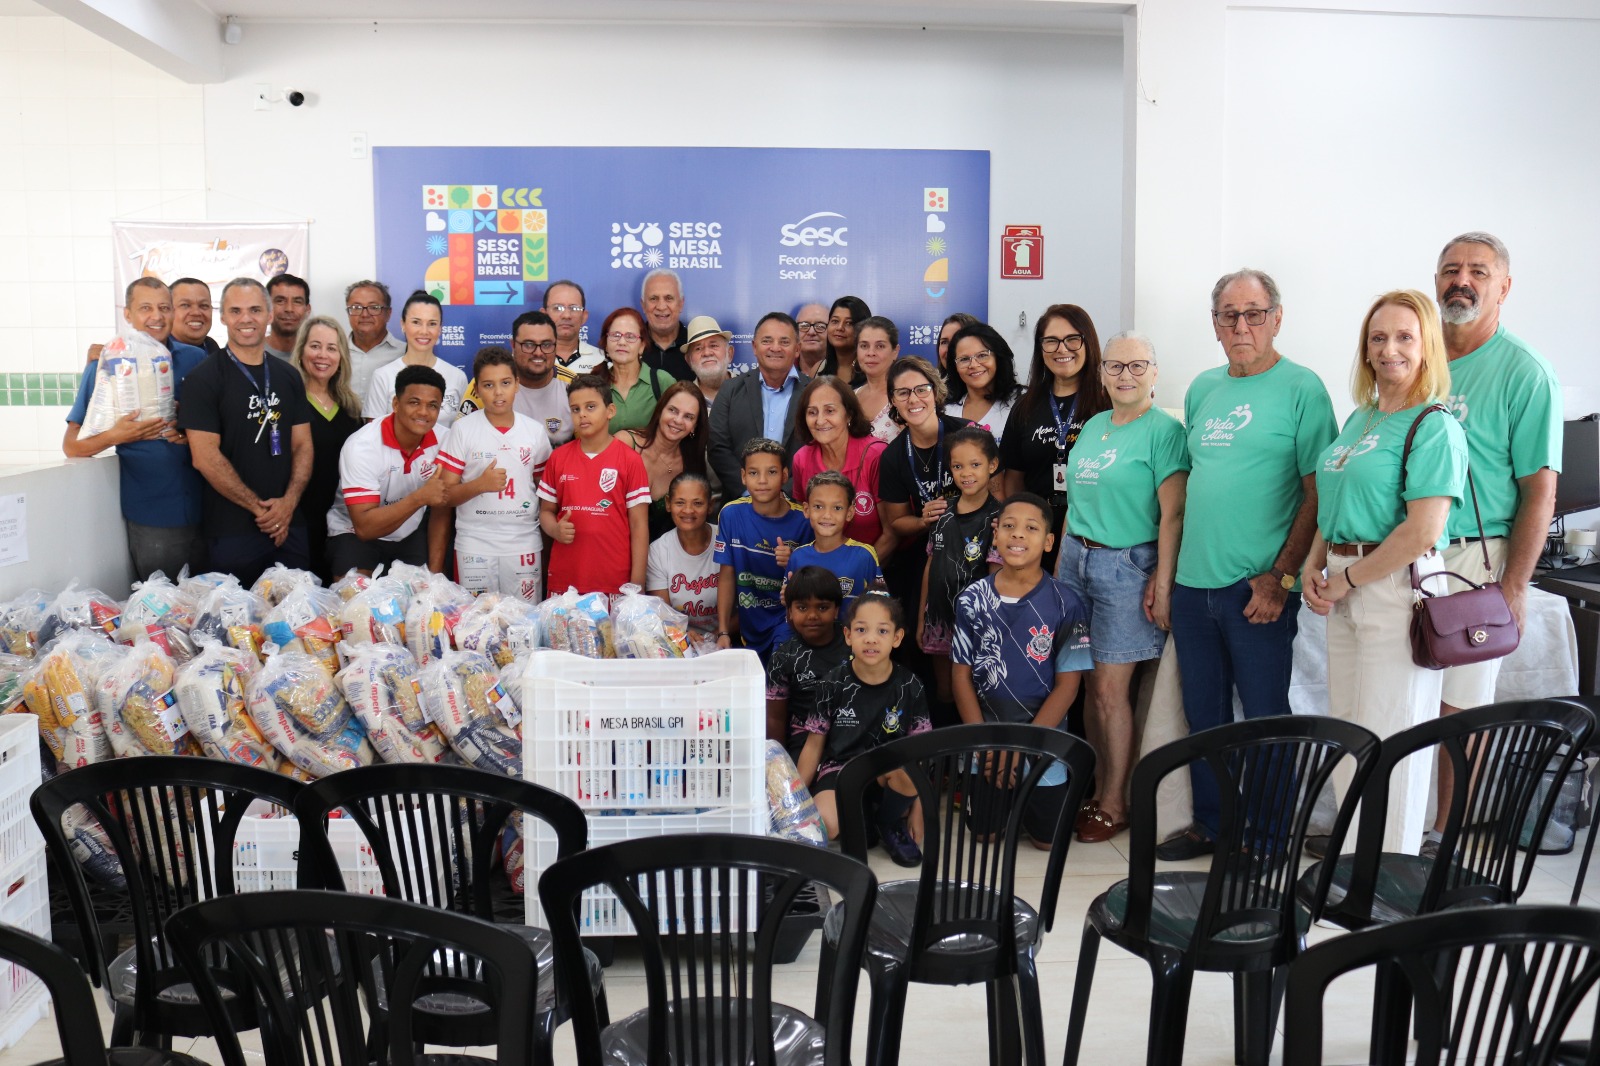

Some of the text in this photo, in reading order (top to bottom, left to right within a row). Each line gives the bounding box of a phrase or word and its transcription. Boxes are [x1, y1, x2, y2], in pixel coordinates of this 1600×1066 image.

[668, 222, 722, 238] SESC
[780, 213, 848, 247] Sesc
[476, 239, 520, 252] SESC
[668, 240, 723, 255] MESA
[477, 252, 520, 265] MESA
[669, 257, 723, 269] BRASIL
[778, 254, 848, 266] Fecomércio
[477, 265, 520, 276] BRASIL
[779, 269, 817, 280] Senac
[1205, 417, 1235, 431] Vida
[1201, 430, 1235, 440] Ativa
[1077, 457, 1101, 469] Vida
[1075, 469, 1100, 479] Ativa
[370, 683, 380, 717] Imperi
[447, 690, 463, 725] Imperial
[600, 717, 684, 729] MESA BRASIL GPI
